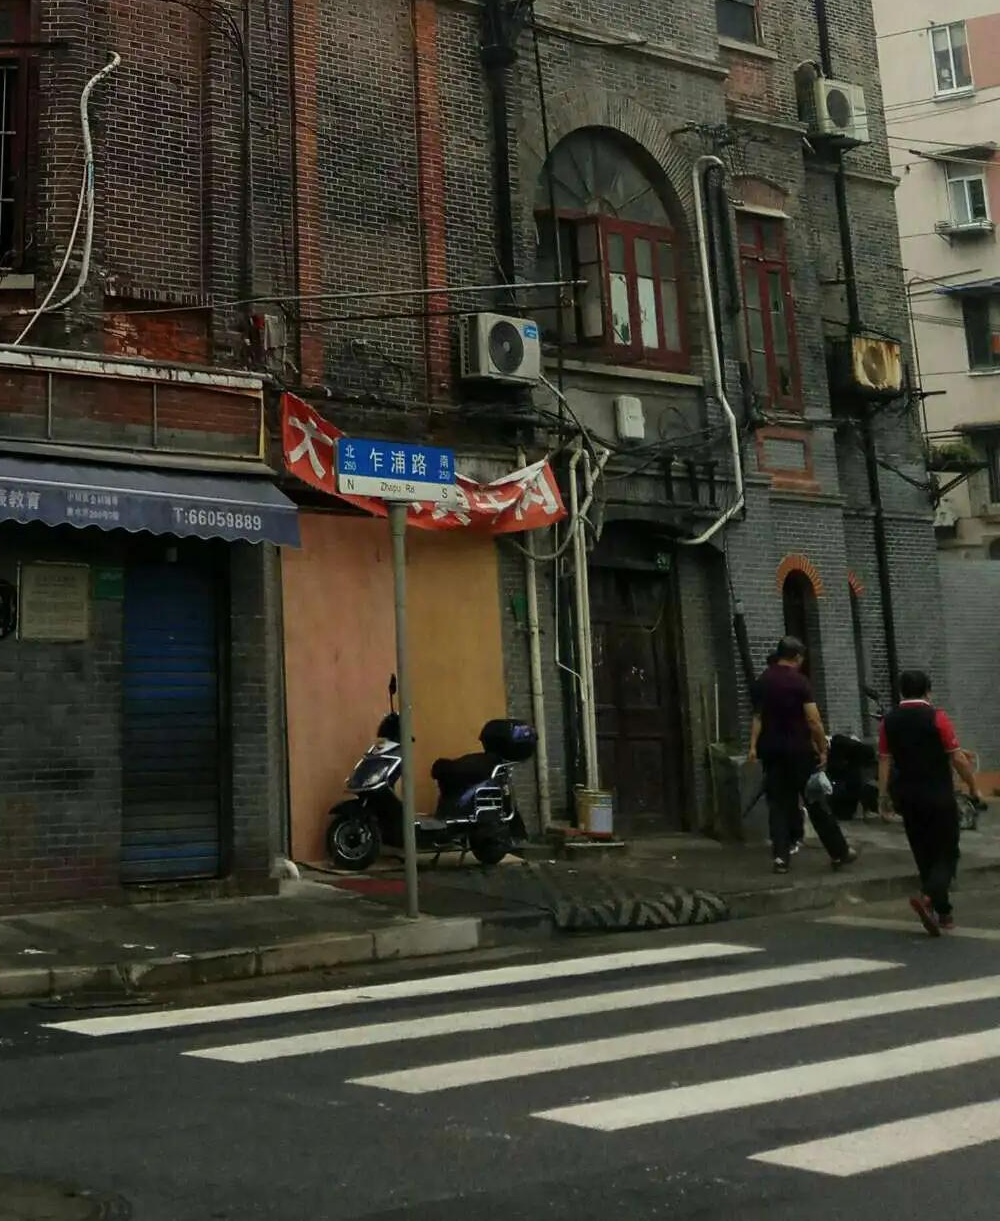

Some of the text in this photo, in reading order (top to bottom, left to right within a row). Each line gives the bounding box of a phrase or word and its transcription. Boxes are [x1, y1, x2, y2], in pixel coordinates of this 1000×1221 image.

[344, 444, 355, 459] 北
[369, 446, 428, 476] 乍浦路
[439, 454, 449, 469] 南
[347, 478, 354, 491] N
[380, 481, 402, 496] Zhapu
[441, 487, 448, 499] S
[172, 507, 262, 531] T:66059889
